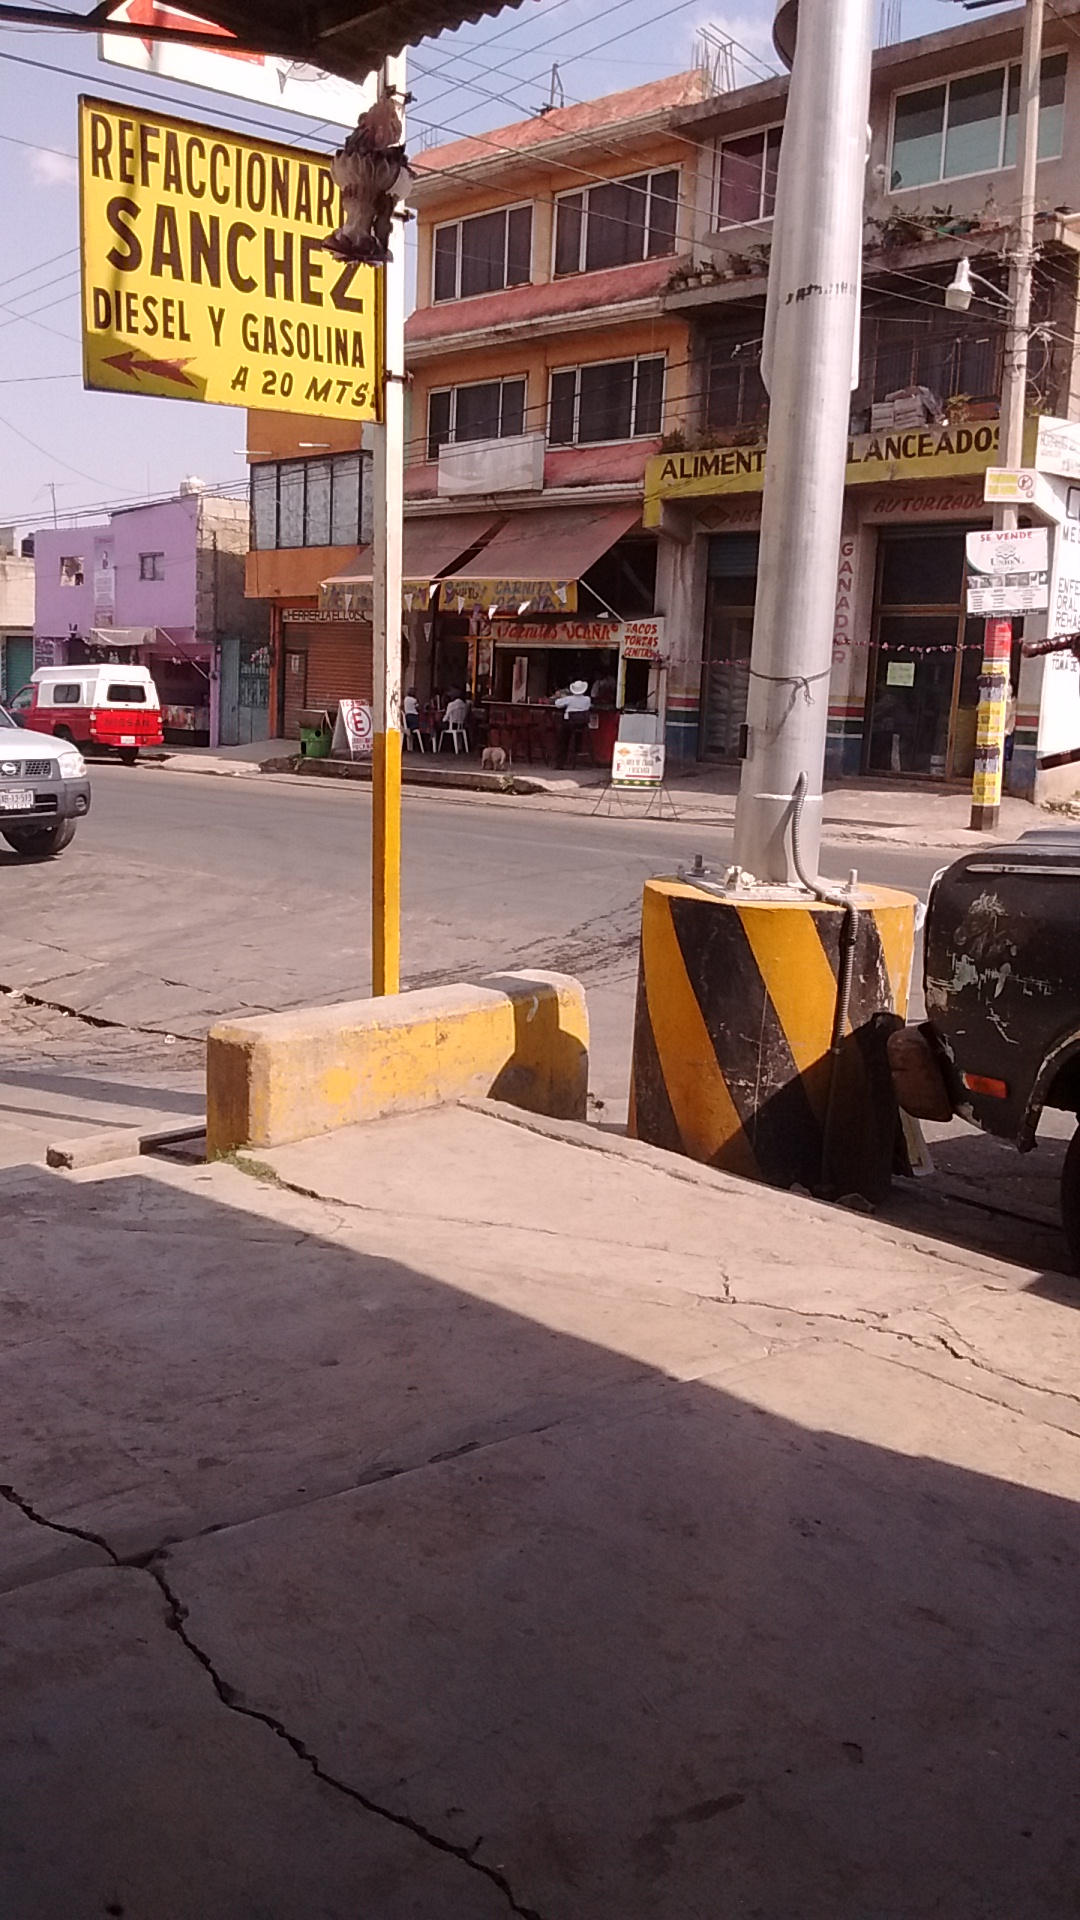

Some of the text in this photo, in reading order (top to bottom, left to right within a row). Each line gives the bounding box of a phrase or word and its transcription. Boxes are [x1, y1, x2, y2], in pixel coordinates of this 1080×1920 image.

[105, 196, 364, 314] SANCHEZ
[93, 287, 366, 369] DIESEL Y GASOLINA
[231, 365, 249, 392] A
[261, 370, 293, 397] 20
[980, 531, 1033, 542] SE VENDE
[1057, 594, 1078, 613] ORAL
[625, 623, 658, 635] TACOS
[624, 635, 659, 648] TORTAS
[105, 718, 150, 727] NISSAN
